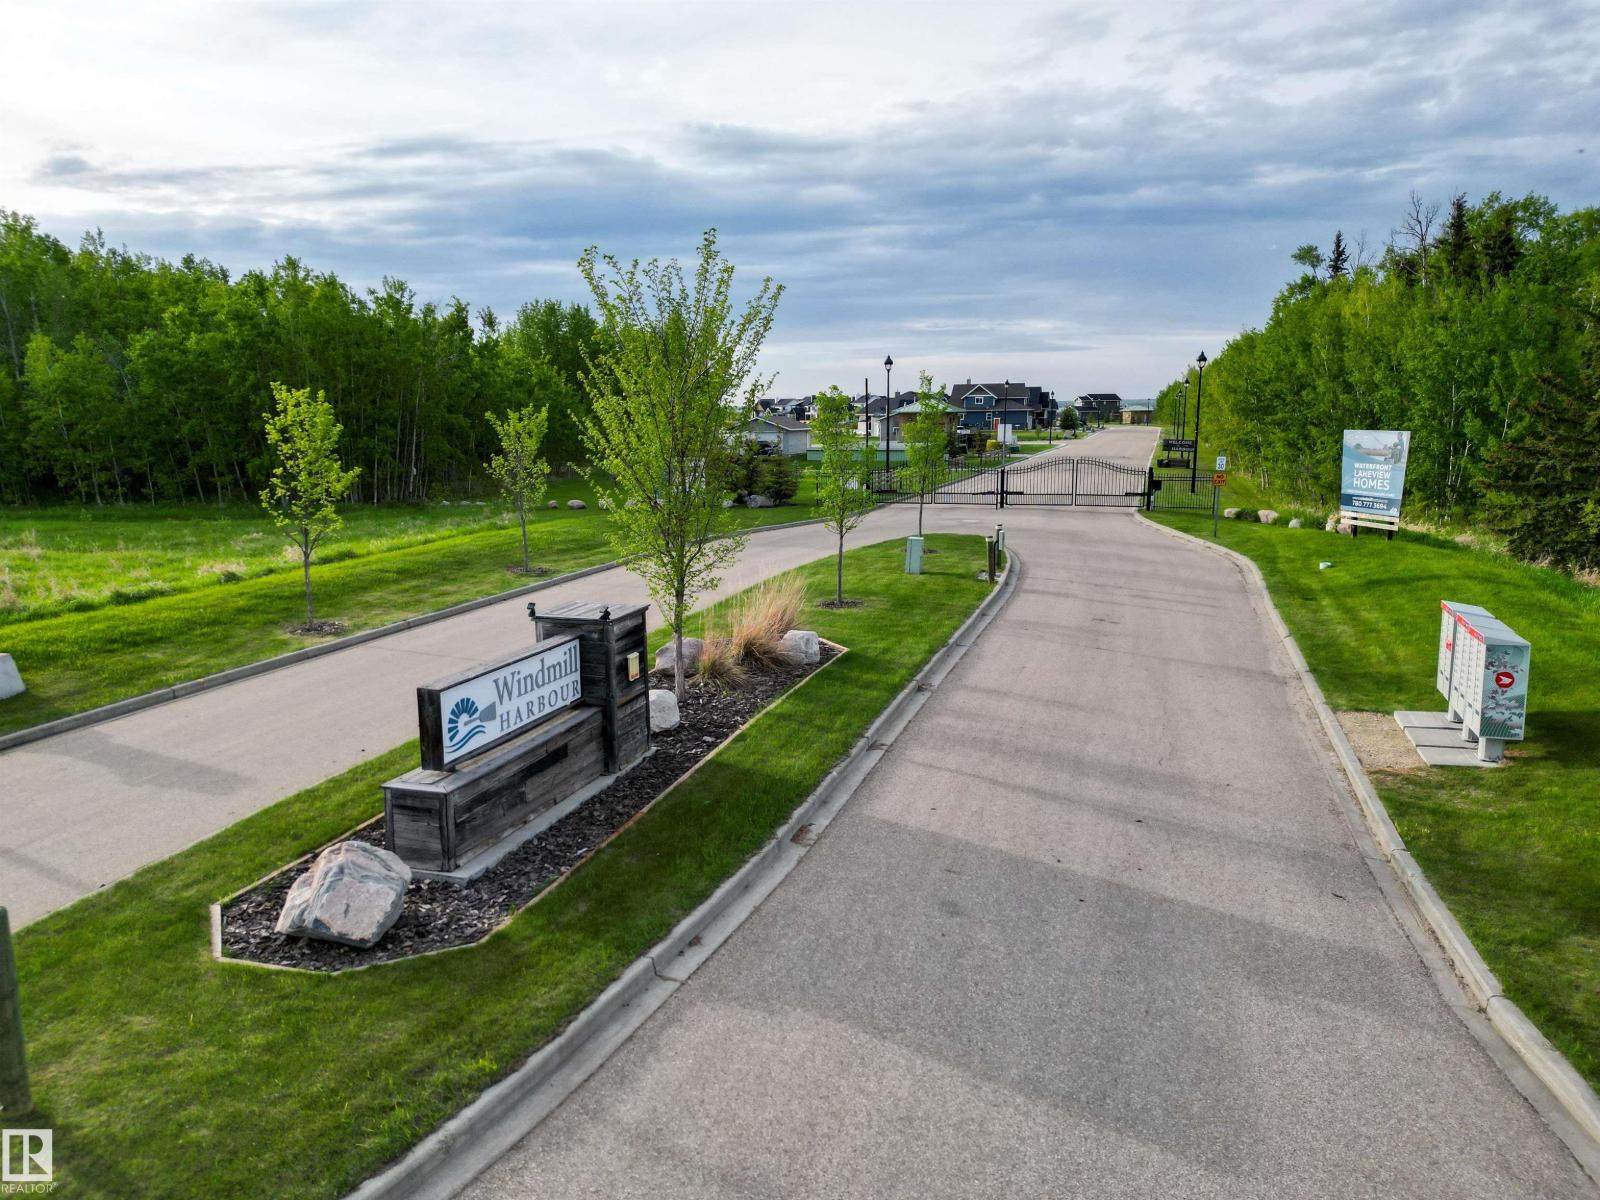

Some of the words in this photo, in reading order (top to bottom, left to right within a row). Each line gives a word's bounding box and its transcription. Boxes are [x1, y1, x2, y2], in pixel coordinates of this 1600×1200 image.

[1354, 463, 1392, 471] WATERFRONT
[1354, 470, 1391, 479] LAKEVIEW
[1353, 478, 1390, 490] HOMES
[493, 644, 578, 705] Windmill
[500, 679, 580, 733] HARBOUR
